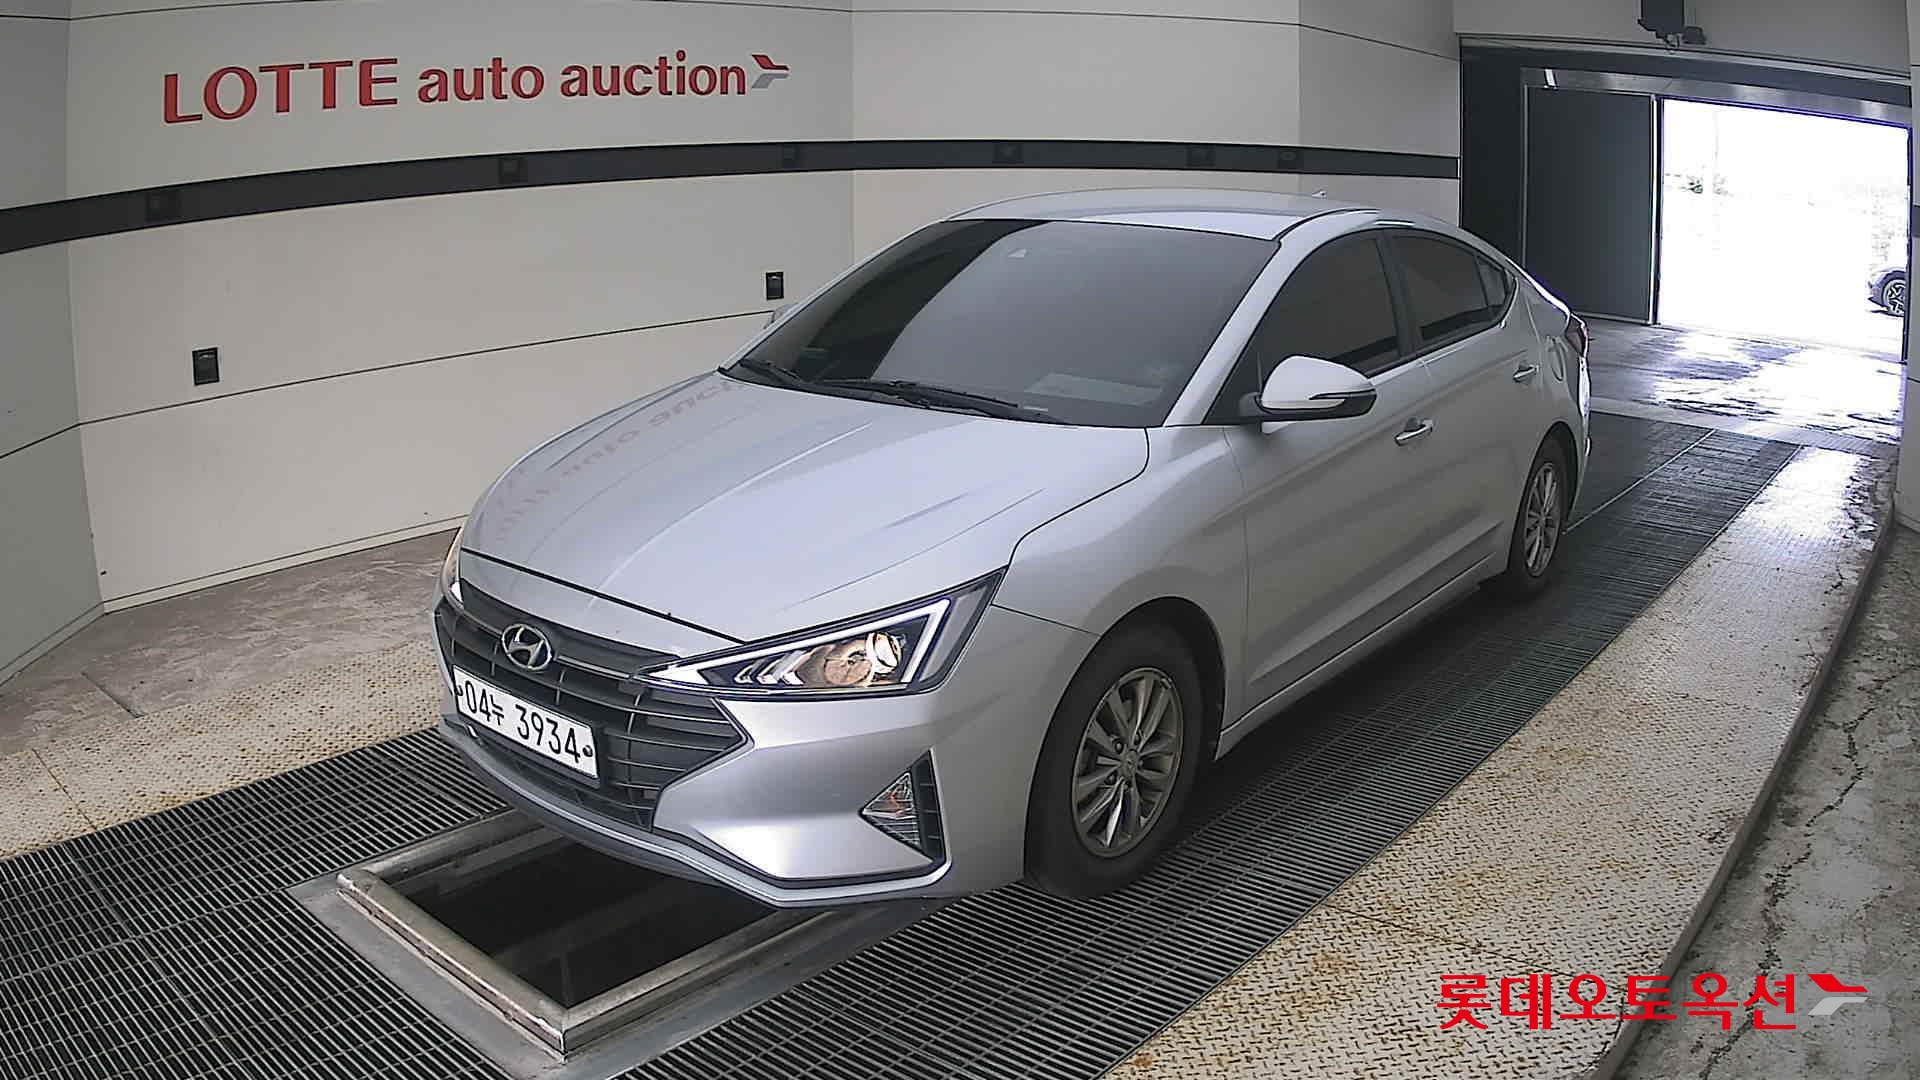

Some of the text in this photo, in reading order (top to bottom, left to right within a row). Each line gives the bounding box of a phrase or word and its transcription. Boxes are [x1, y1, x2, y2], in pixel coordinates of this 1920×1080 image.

[163, 50, 748, 124] LOTTE auto auction
[465, 680, 581, 764] 04누 3934
